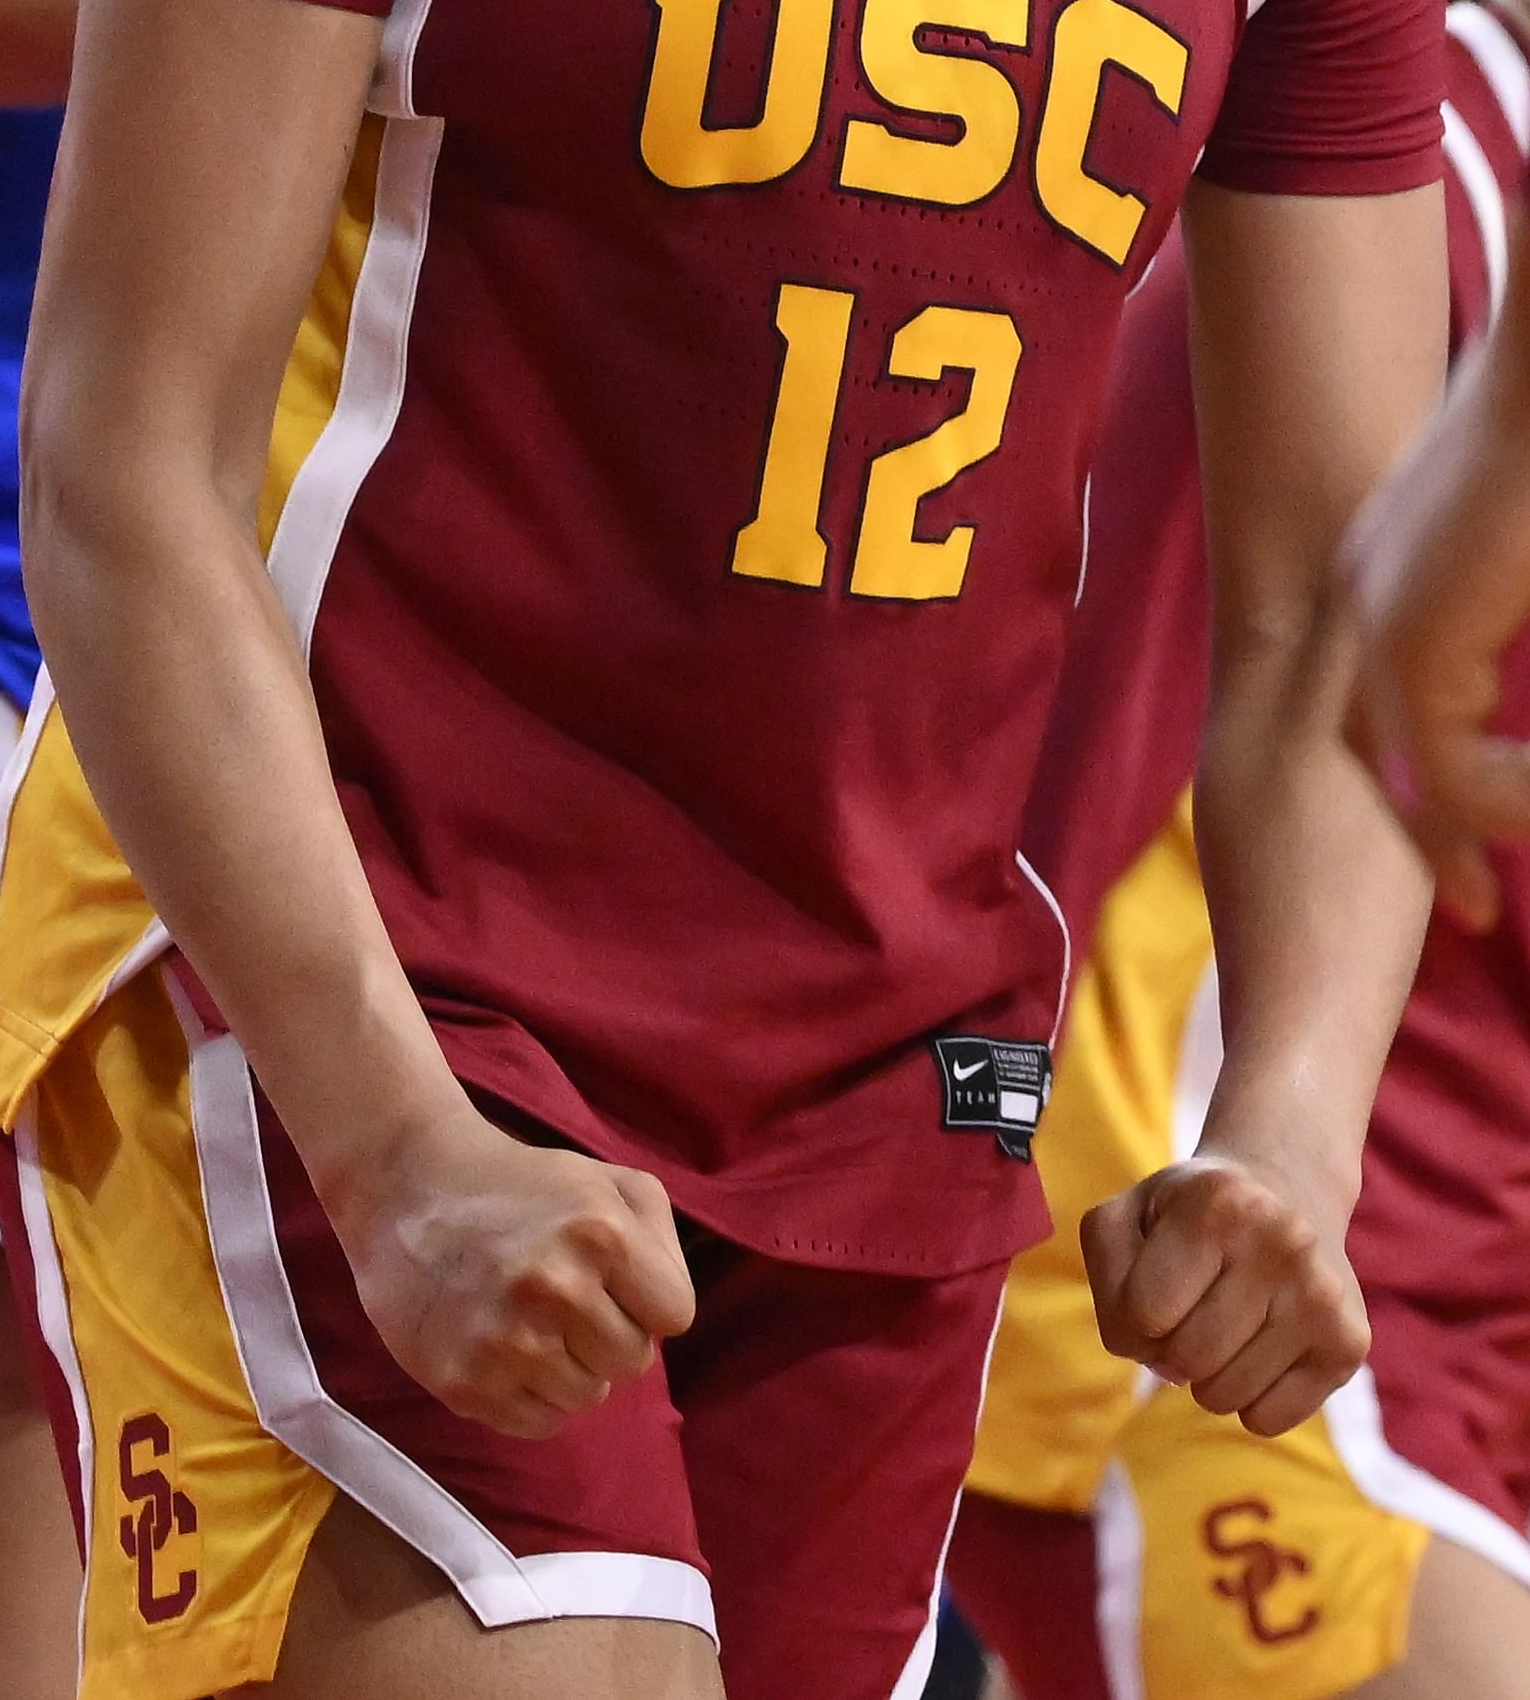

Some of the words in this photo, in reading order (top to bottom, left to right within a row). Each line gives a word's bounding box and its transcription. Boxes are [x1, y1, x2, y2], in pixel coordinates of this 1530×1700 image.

[728, 280, 1023, 602] 12
[120, 1412, 198, 1625] SC
[1202, 1498, 1322, 1646] SC
